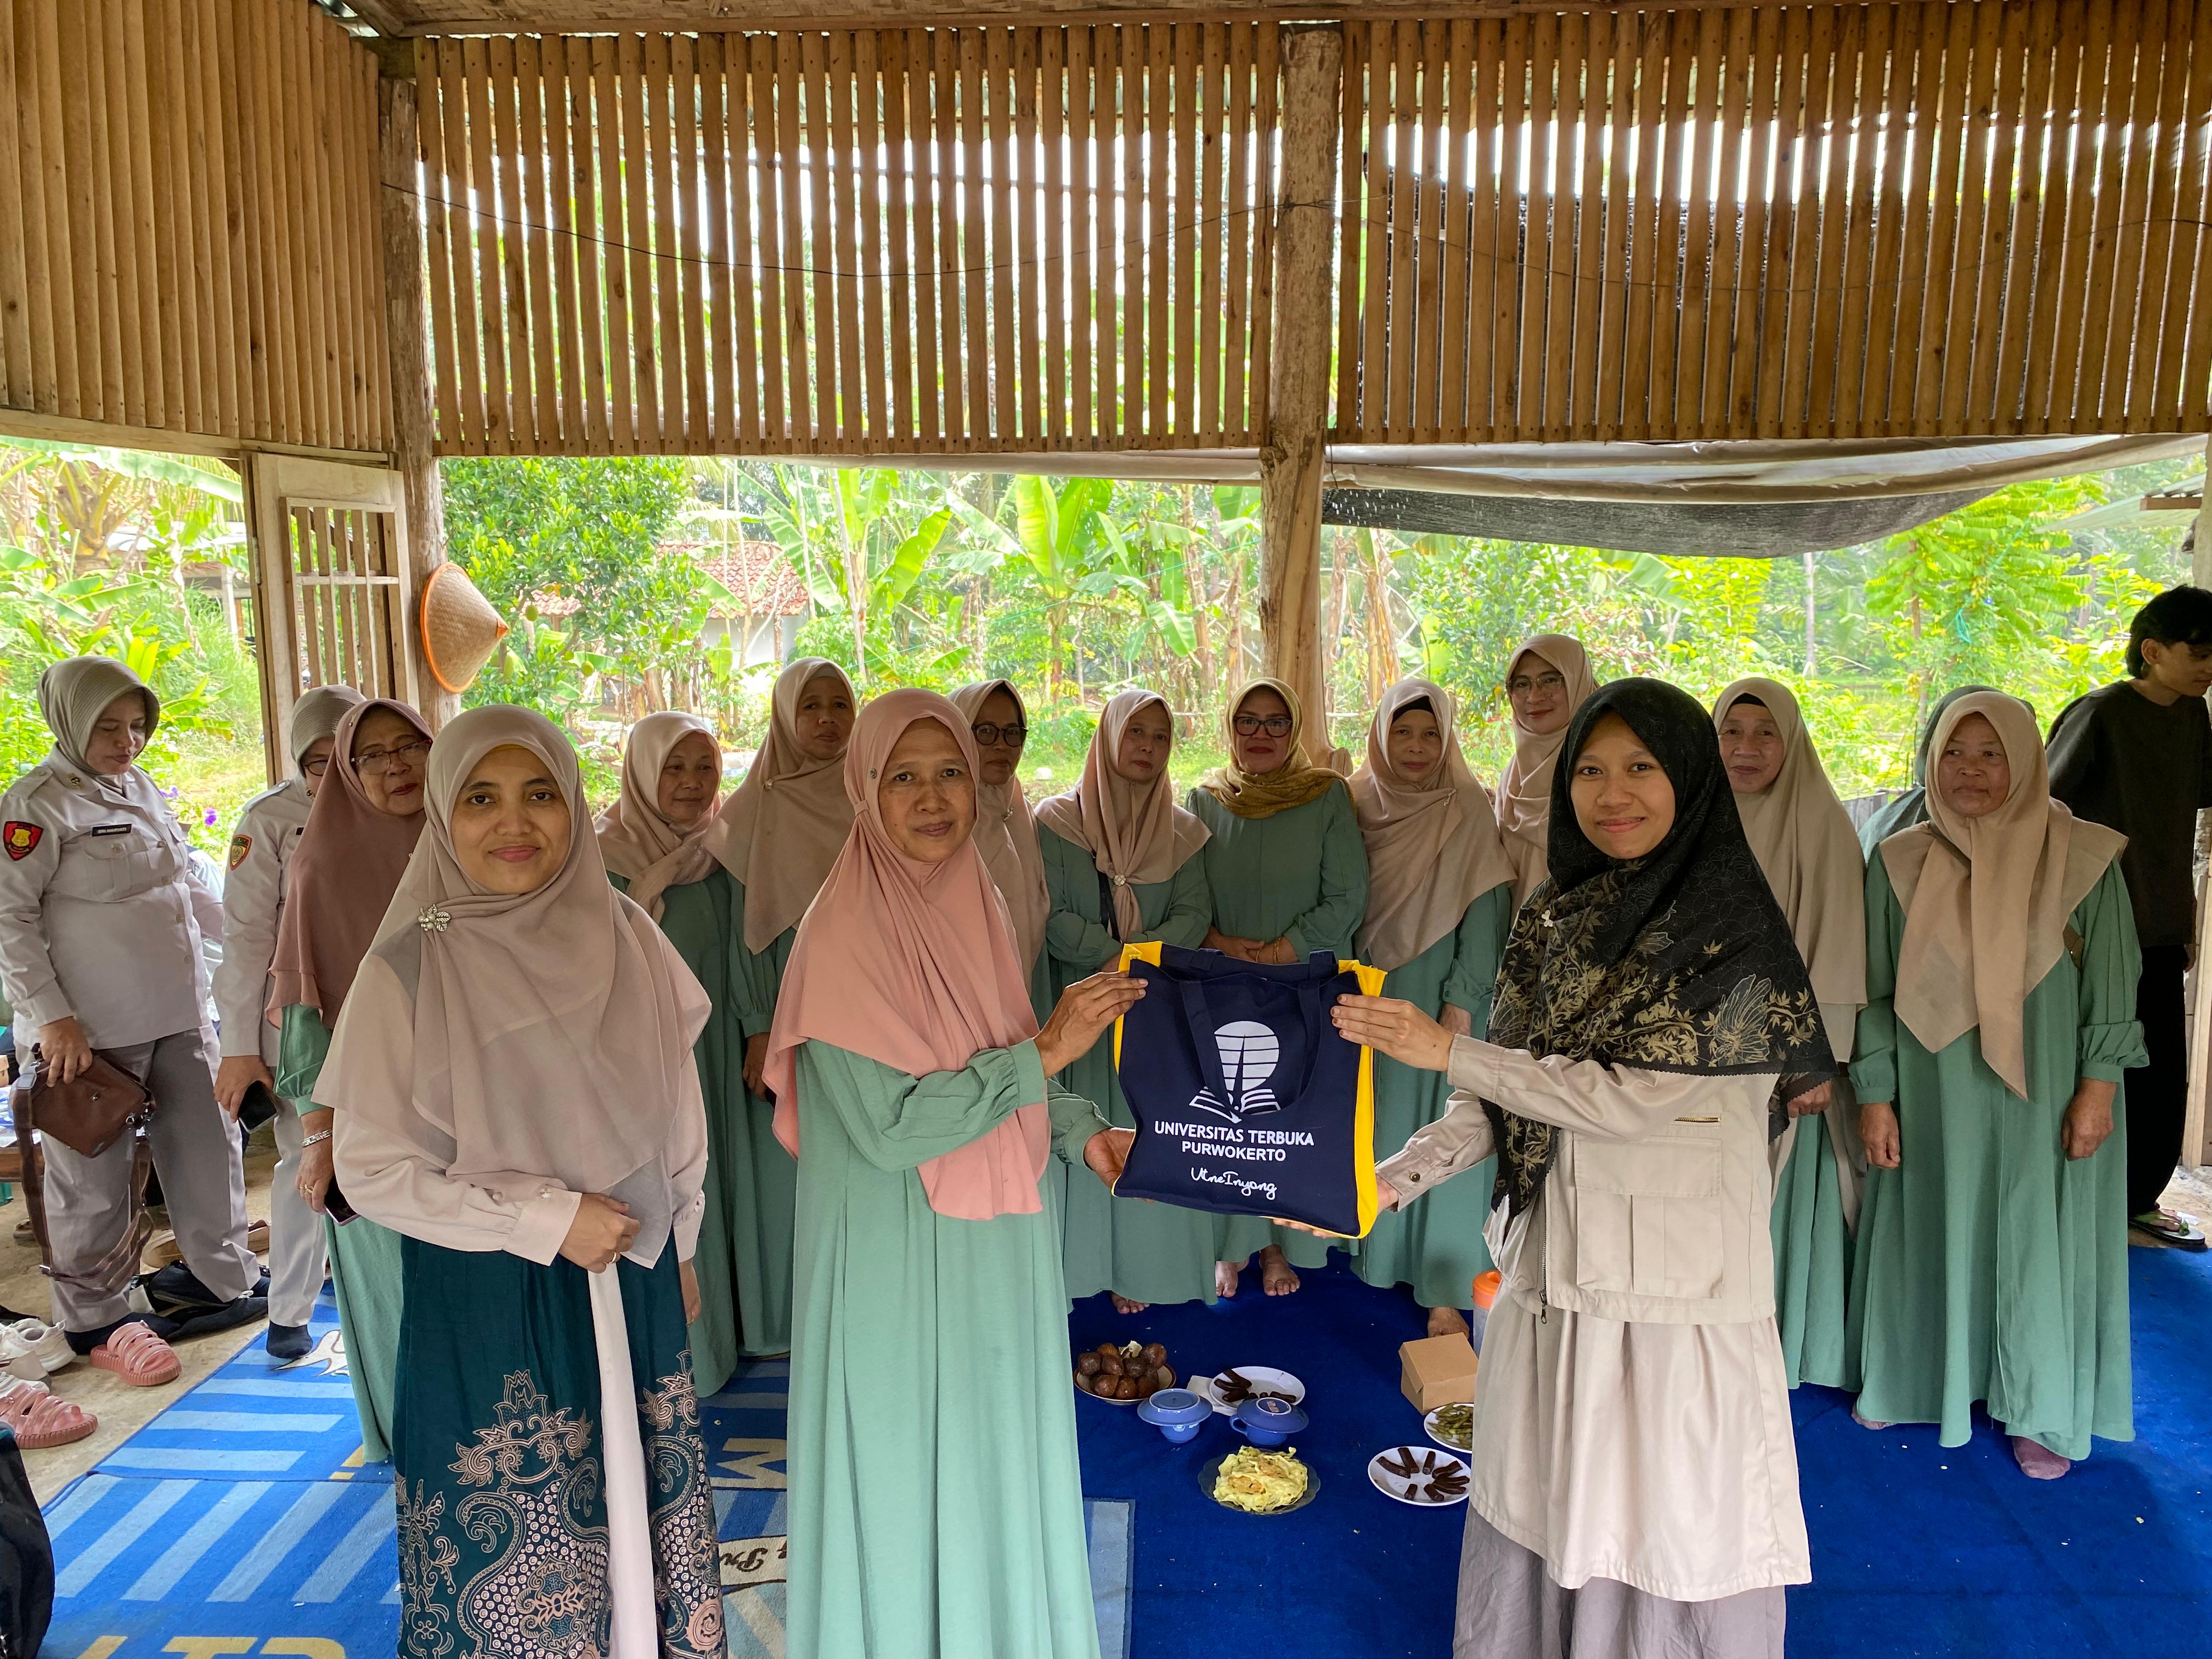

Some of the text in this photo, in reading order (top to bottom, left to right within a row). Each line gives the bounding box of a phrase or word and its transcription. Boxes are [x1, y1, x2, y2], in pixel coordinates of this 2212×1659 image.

[1155, 1120, 1314, 1146] UNIVERSITAS TERBUKA
[1182, 1141, 1286, 1161] PURWOKERTO
